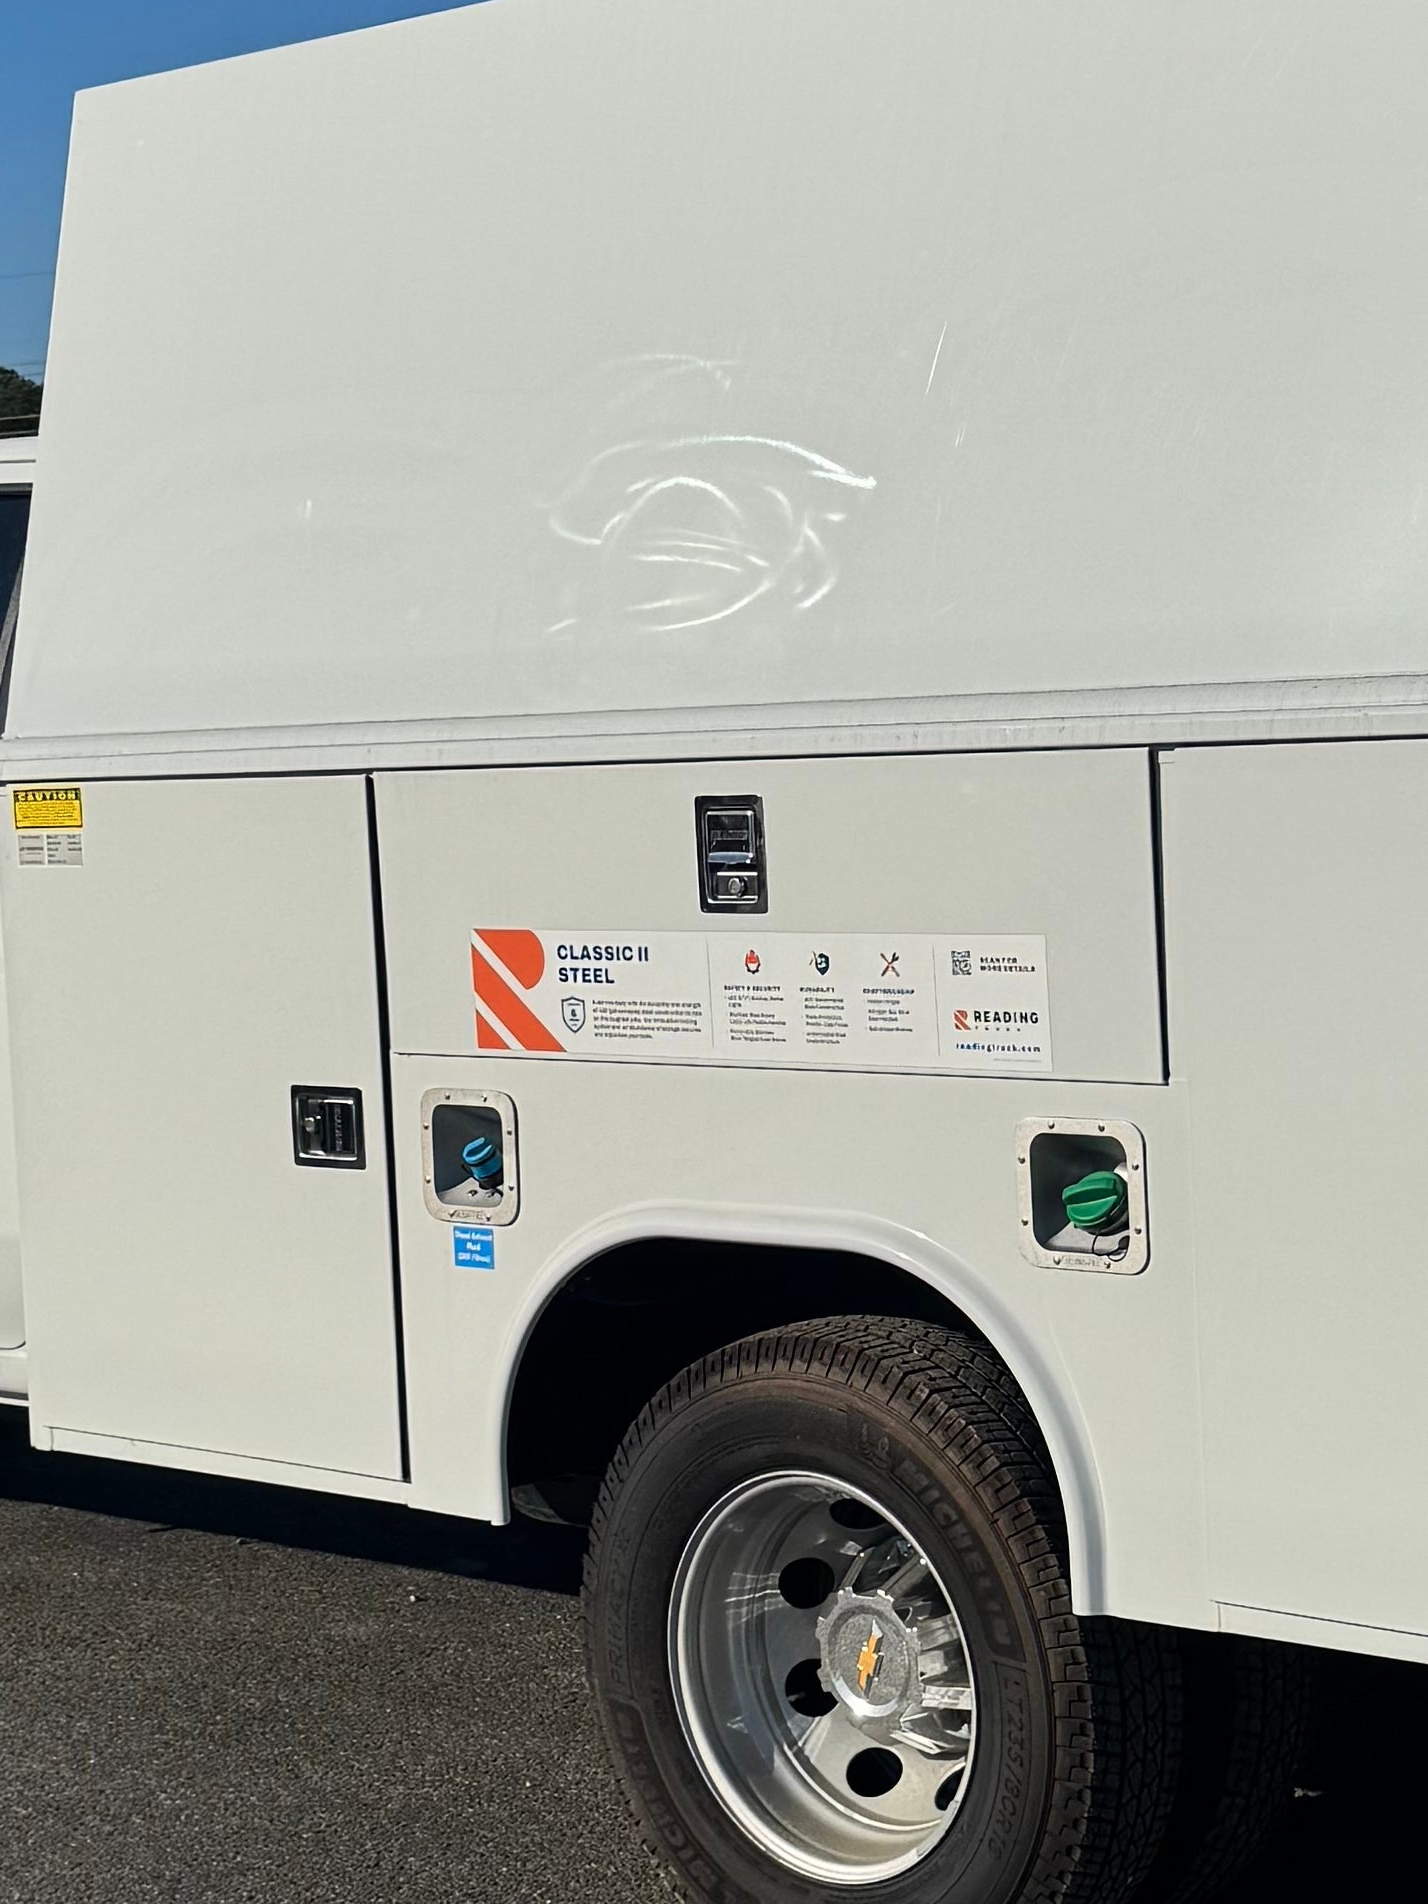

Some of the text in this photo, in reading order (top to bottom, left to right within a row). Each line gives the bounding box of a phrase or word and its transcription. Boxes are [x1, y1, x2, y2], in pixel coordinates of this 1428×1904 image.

[17, 790, 76, 802] CAUTION
[556, 944, 649, 962] CLASSIC II
[558, 967, 615, 984] STEEL
[973, 1010, 1039, 1024] READING
[892, 1456, 1014, 1646] MICHELIN
